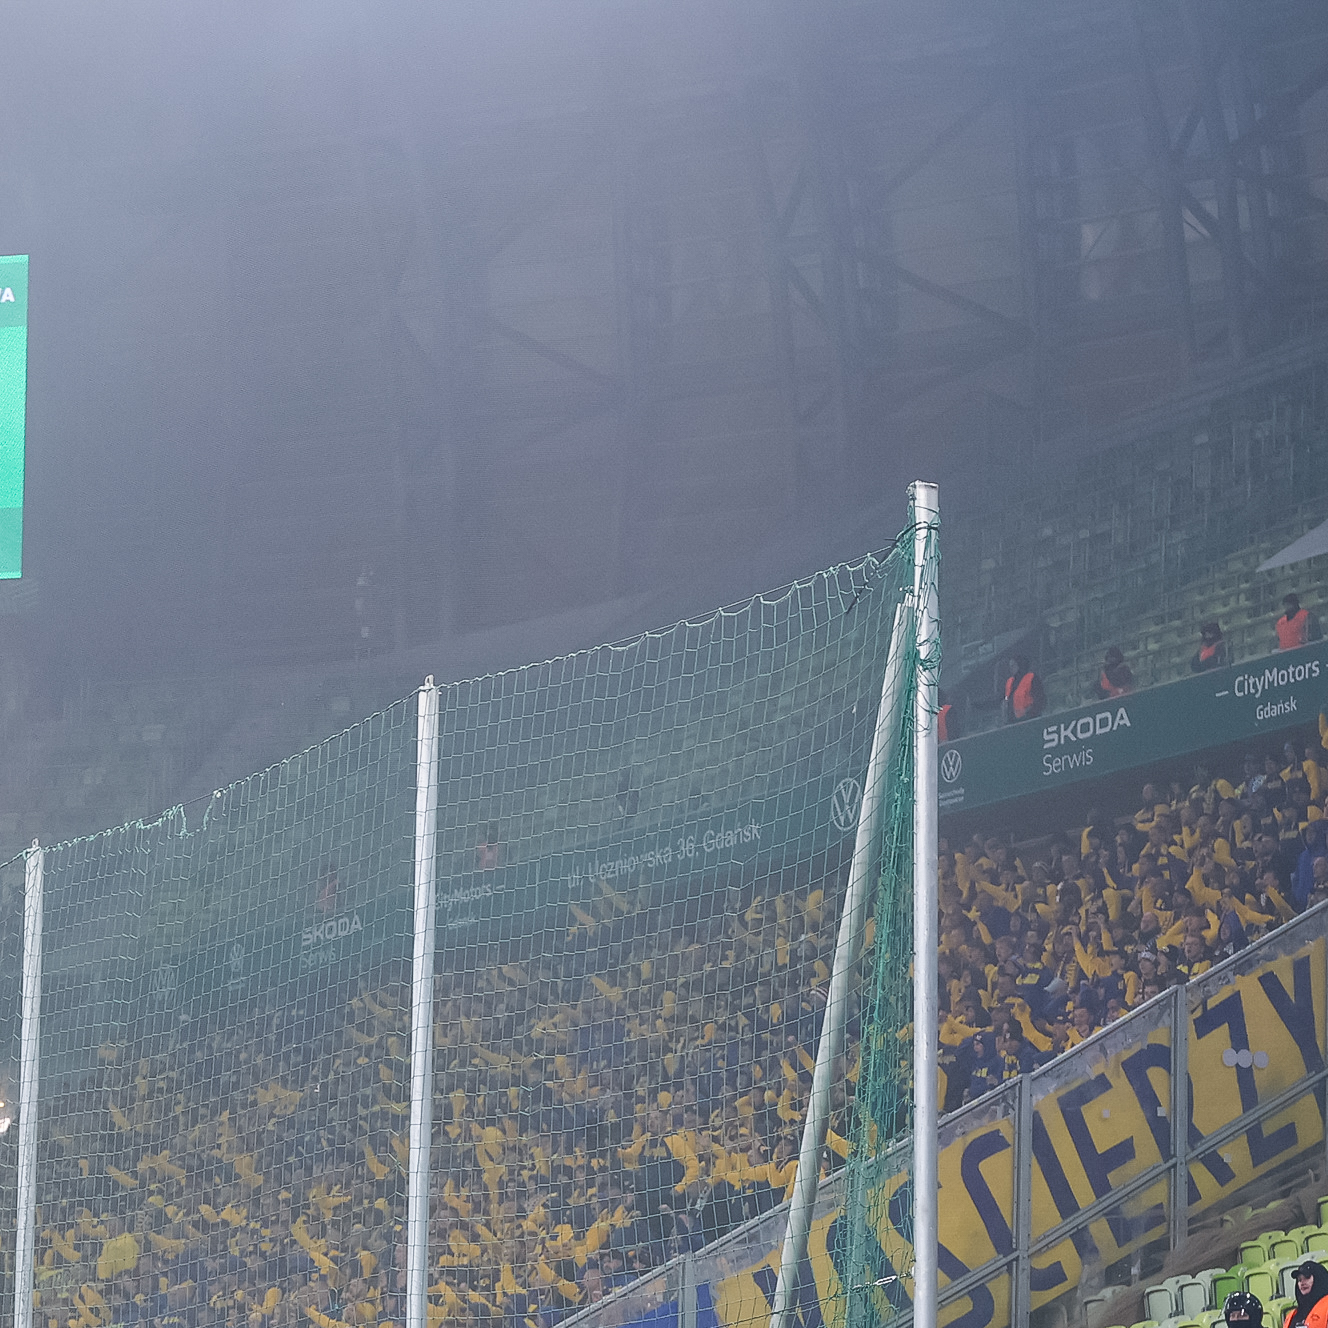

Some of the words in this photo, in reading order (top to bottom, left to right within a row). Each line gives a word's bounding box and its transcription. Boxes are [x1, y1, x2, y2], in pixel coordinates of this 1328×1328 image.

[1234, 659, 1320, 699] CityMotors
[1256, 698, 1298, 721] Gdańsk
[1042, 750, 1094, 776] Serwis
[434, 881, 493, 911] ityMotors
